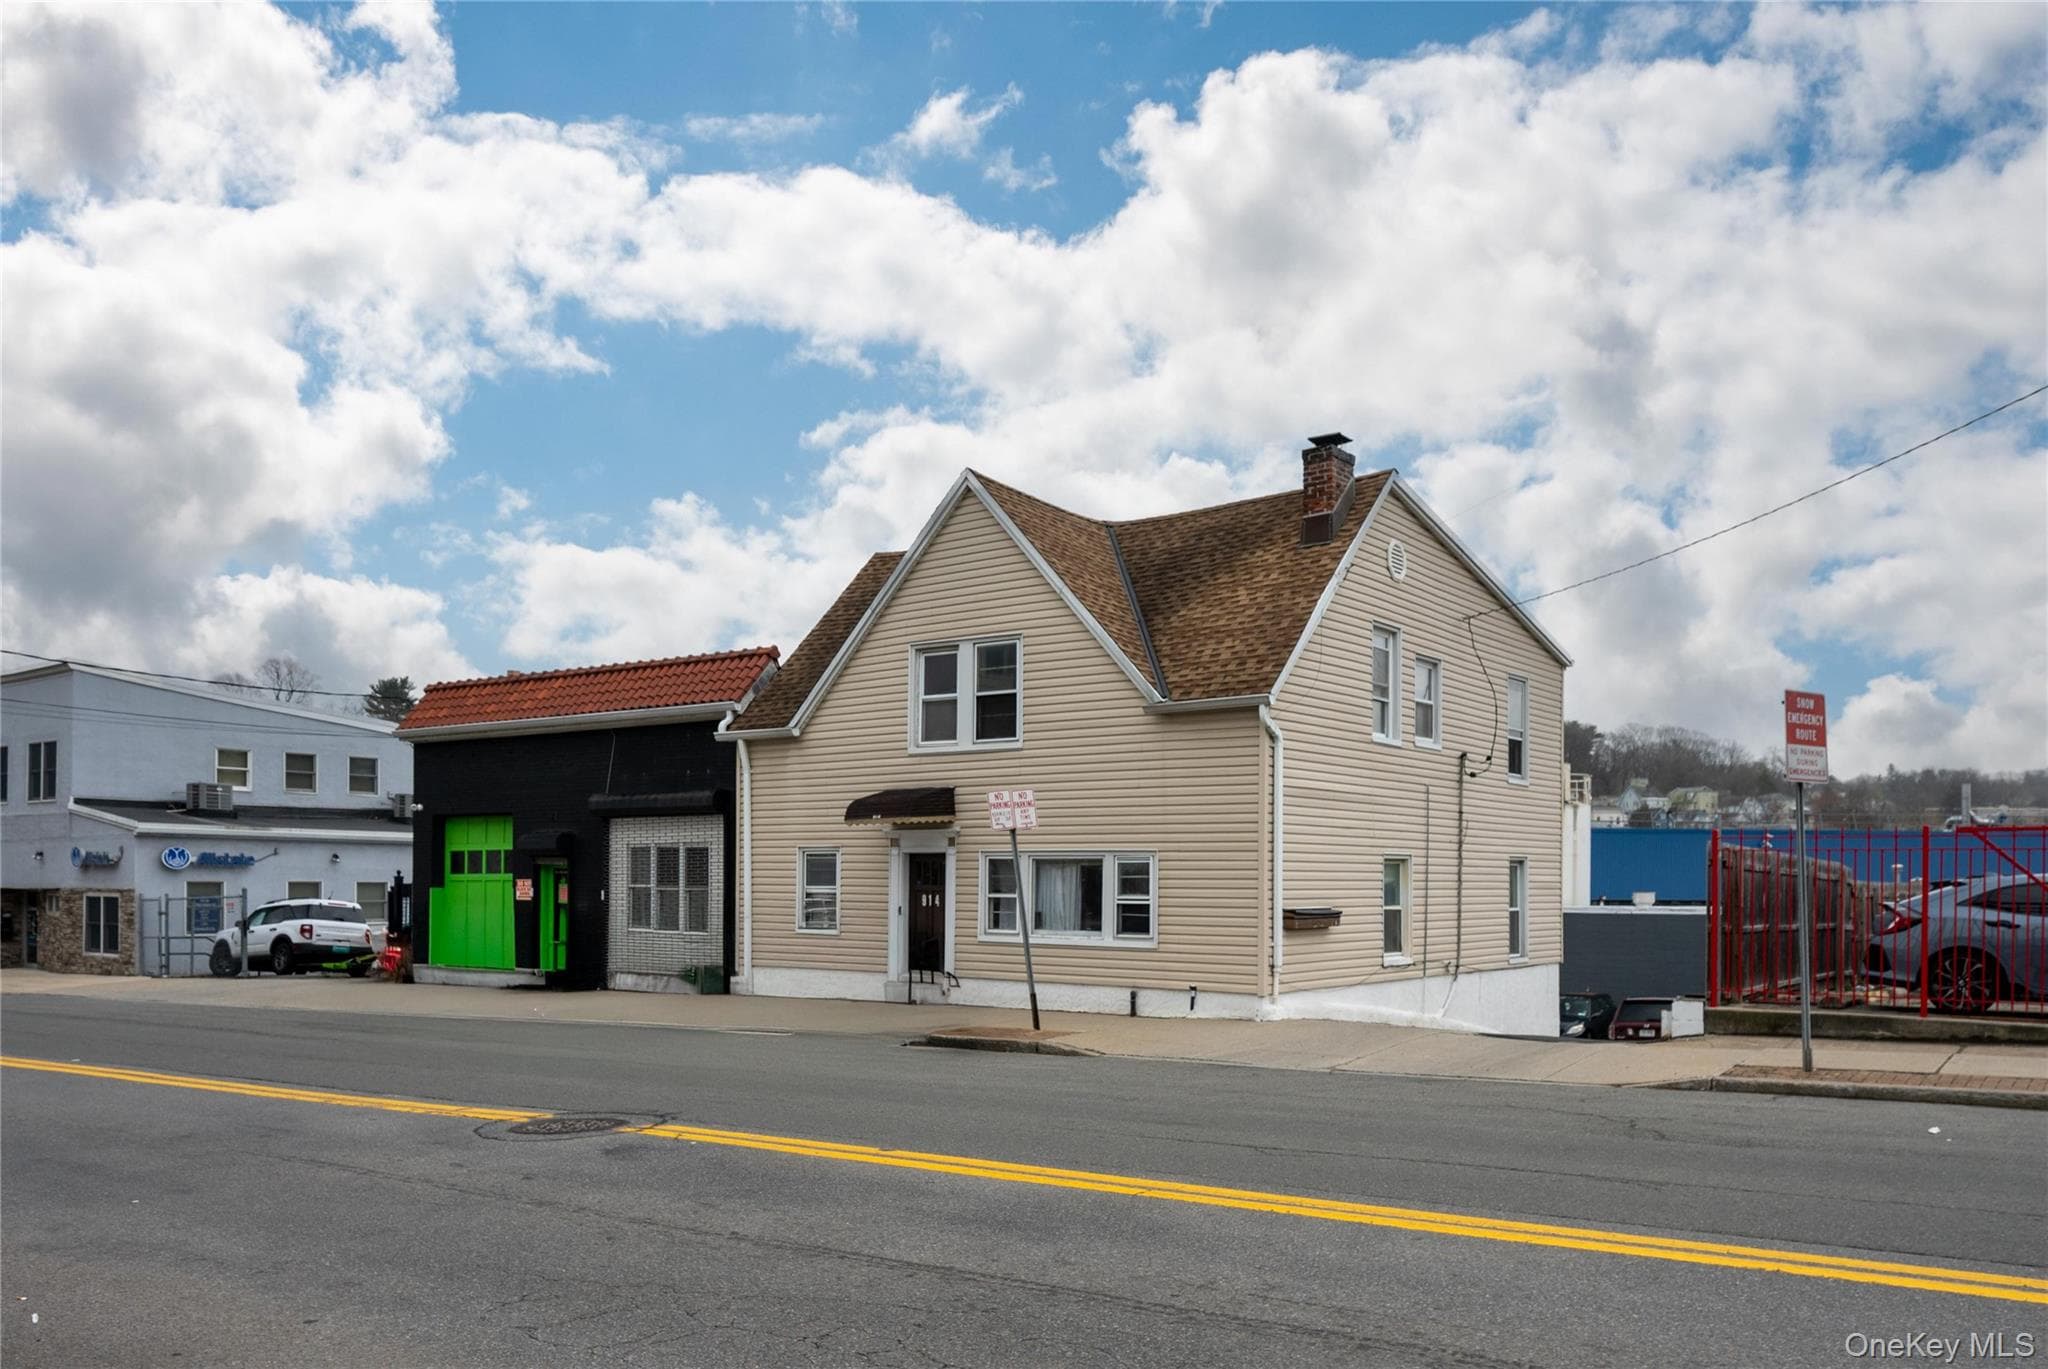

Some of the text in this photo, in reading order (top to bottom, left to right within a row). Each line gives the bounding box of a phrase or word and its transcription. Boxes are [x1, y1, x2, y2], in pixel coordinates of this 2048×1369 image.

[1796, 697, 1814, 709] SNOW
[1788, 711, 1823, 726] EMERGENCY
[1796, 728, 1816, 741] ROUTE
[994, 792, 1003, 801] NO
[1018, 791, 1028, 800] NO
[991, 801, 1011, 809] PARKING
[1013, 800, 1034, 808] PARKING
[197, 851, 256, 867] Allstate
